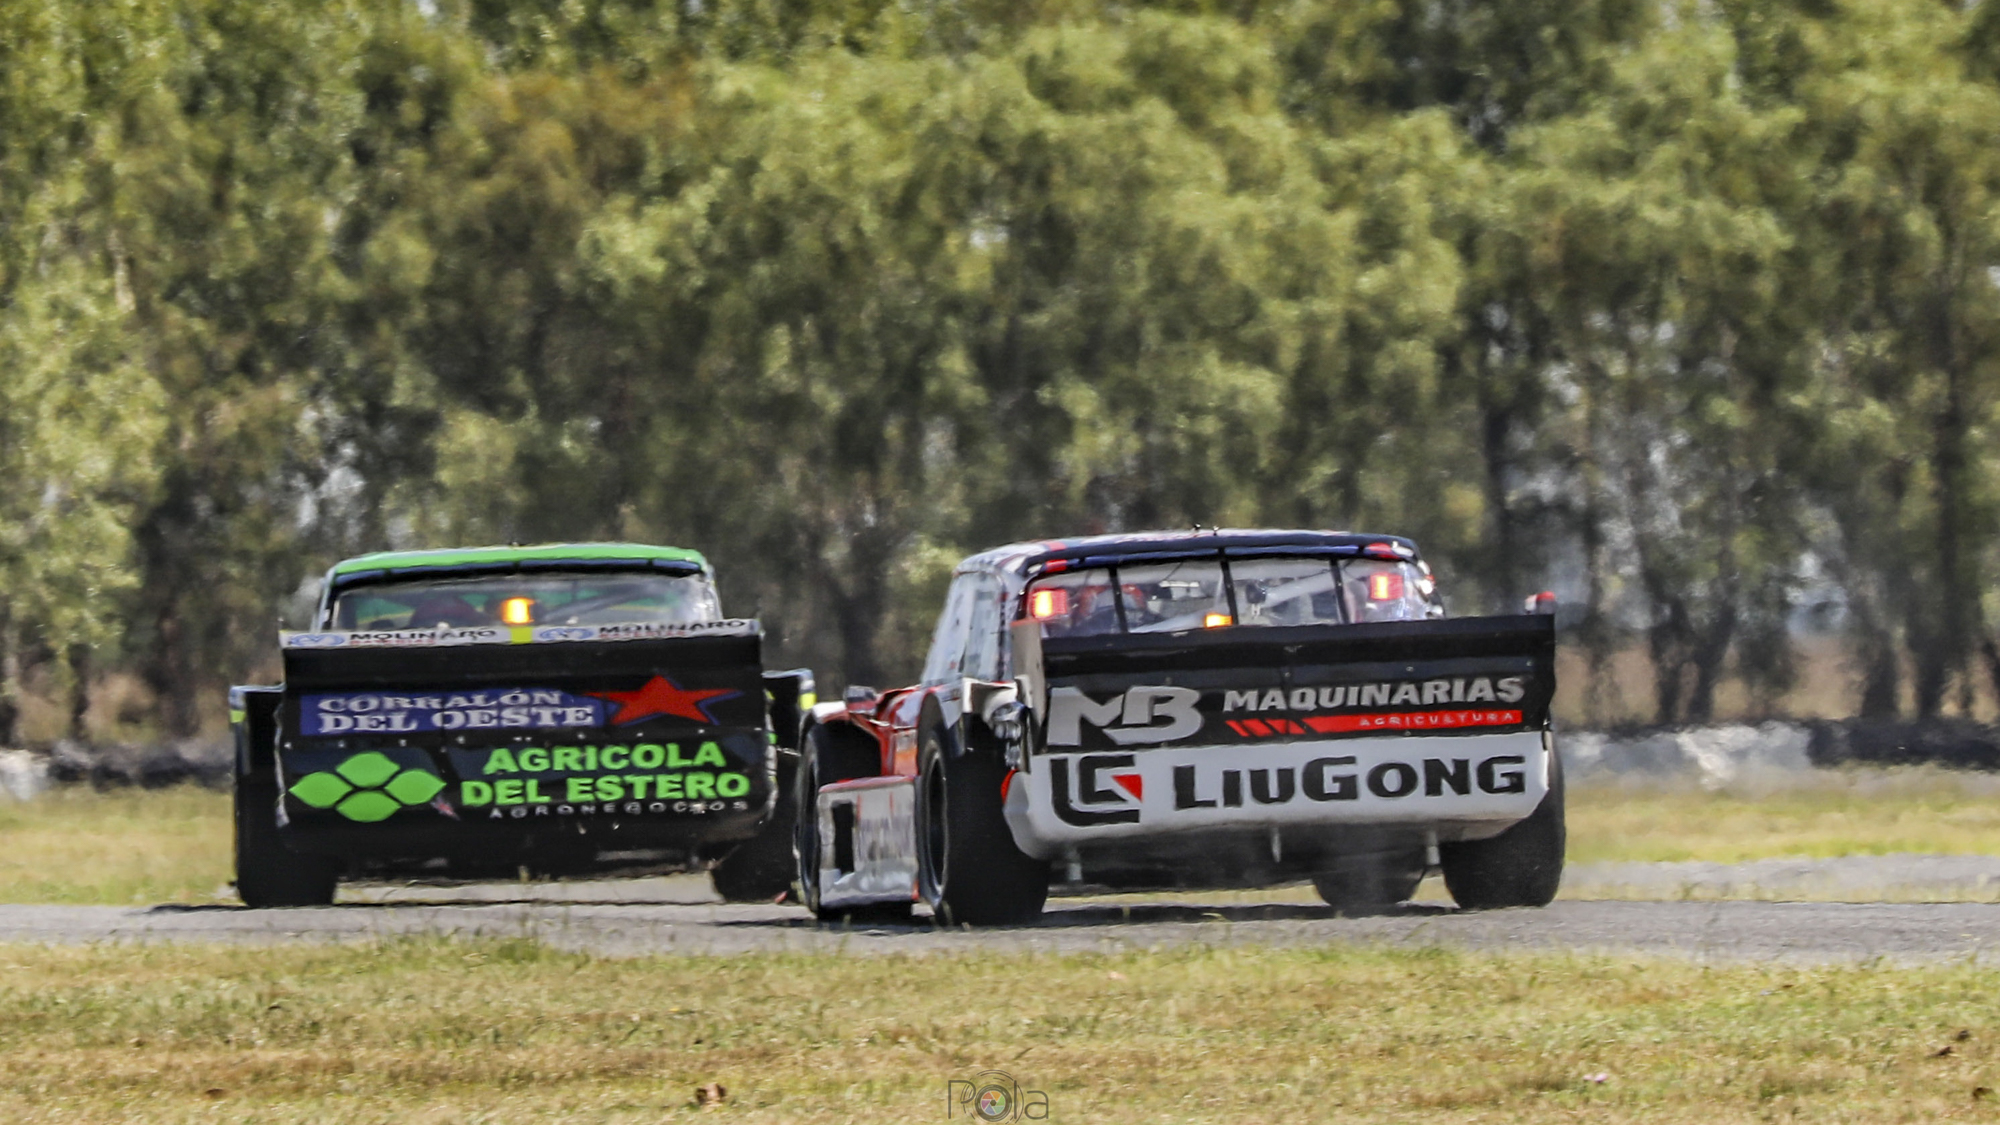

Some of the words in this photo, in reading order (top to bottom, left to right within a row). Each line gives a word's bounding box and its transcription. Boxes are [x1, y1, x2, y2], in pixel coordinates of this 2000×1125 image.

[350, 630, 497, 641] MOLINARO
[318, 688, 563, 712] CORRALÓN
[1222, 677, 1526, 712] MAQUINARIAS
[318, 711, 418, 733] DEL
[431, 705, 596, 730] OESTE
[1047, 685, 1204, 746] MB
[1358, 712, 1514, 727] AGRICULTURA
[482, 741, 726, 775] AGRICOLA
[461, 778, 551, 806] DEL
[566, 771, 750, 802] ESTERO
[1173, 755, 1526, 811] LIUGONG
